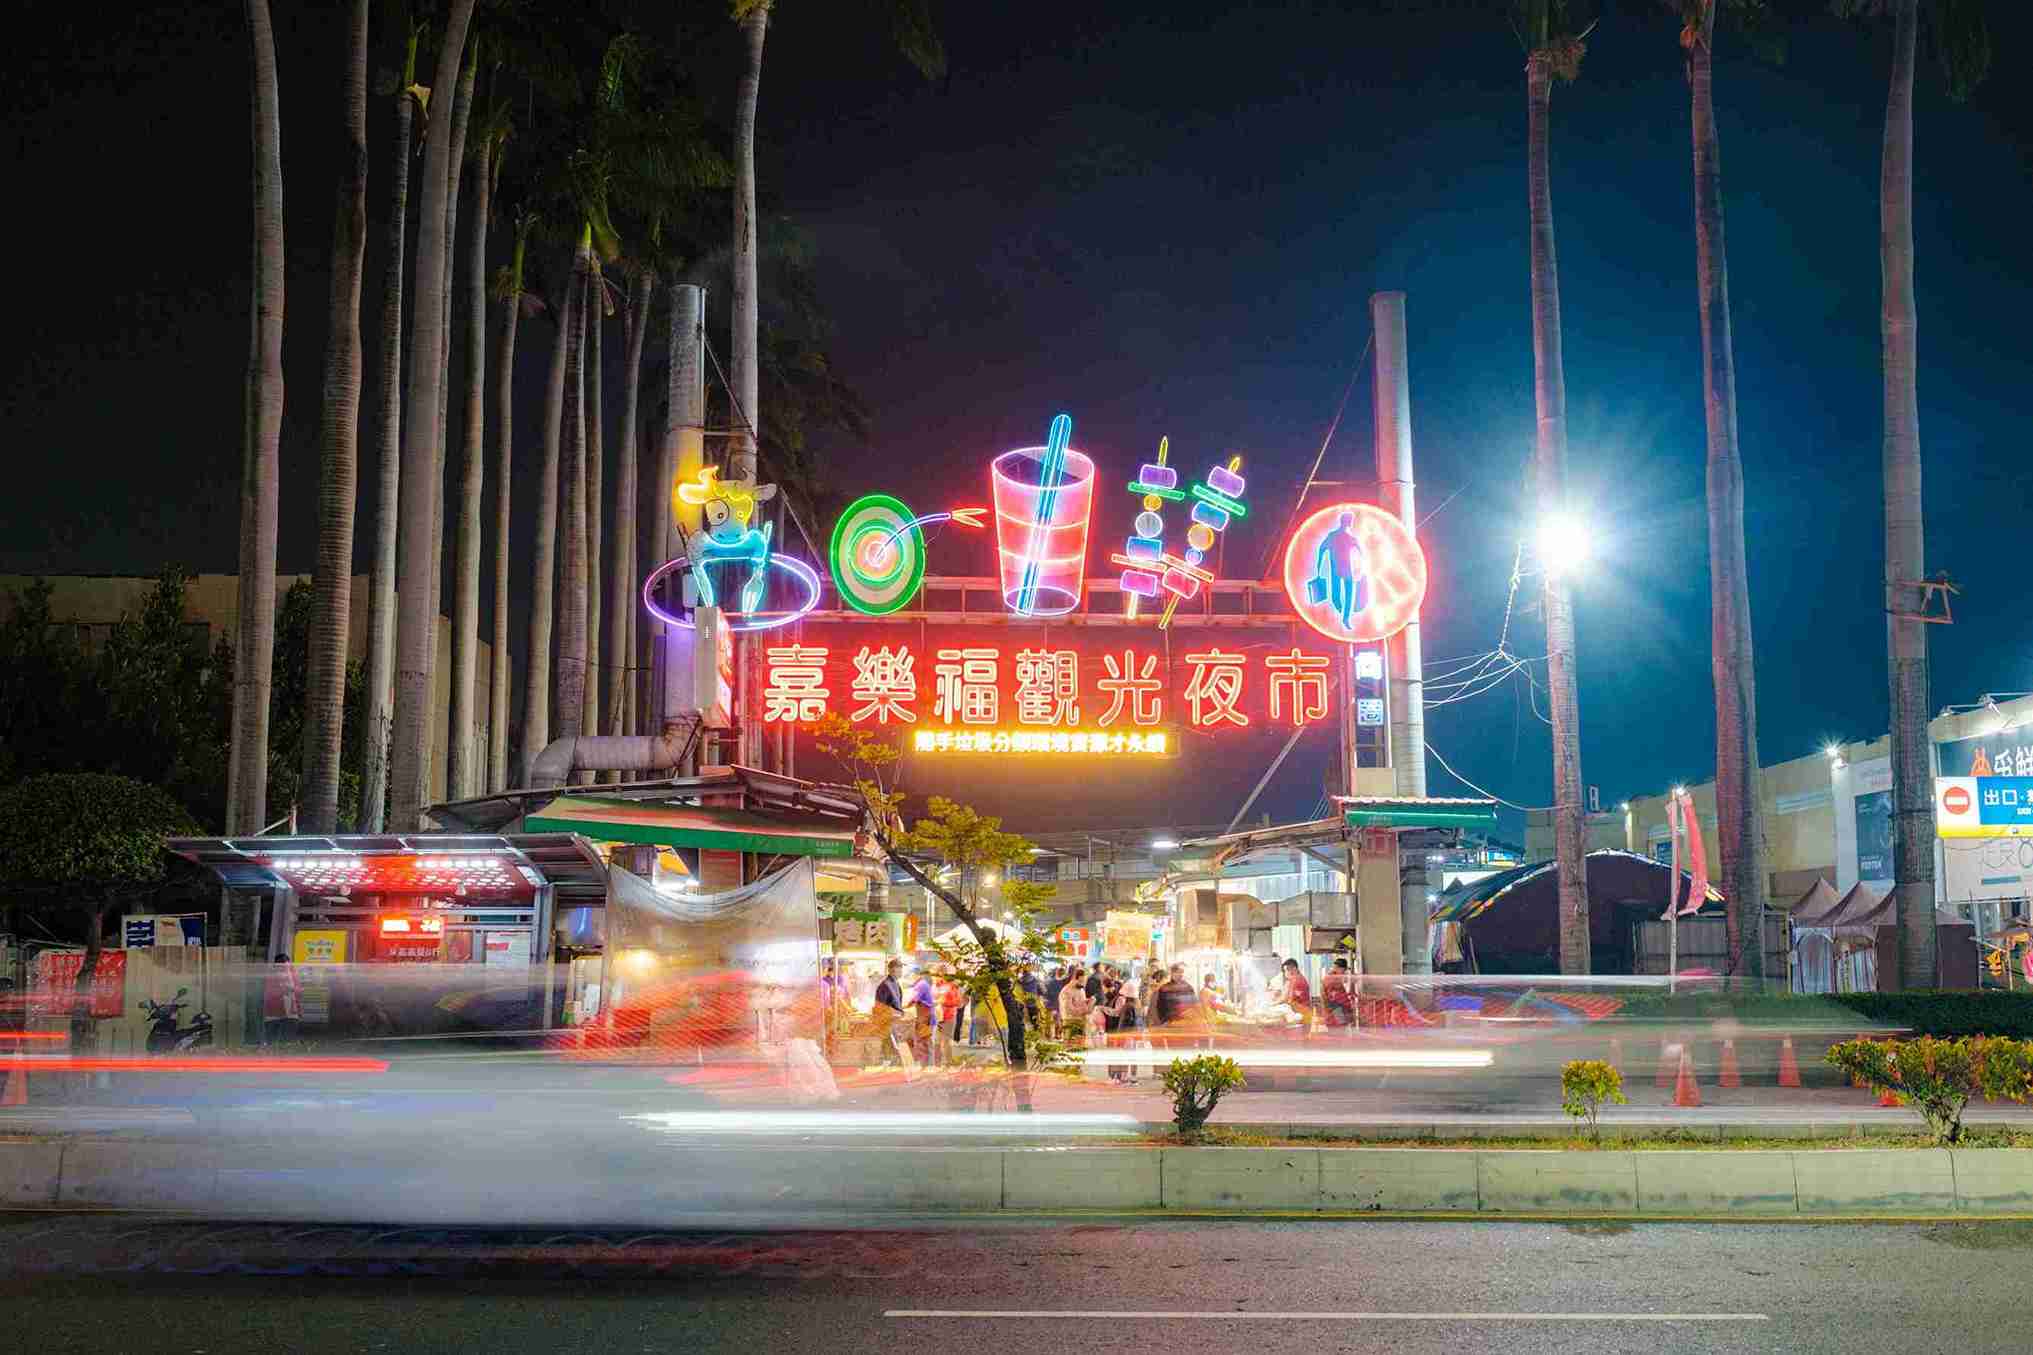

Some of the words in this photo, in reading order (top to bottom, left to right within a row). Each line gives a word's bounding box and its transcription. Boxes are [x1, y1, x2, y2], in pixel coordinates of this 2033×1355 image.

[764, 644, 1332, 726] 嘉樂福觀光夜市
